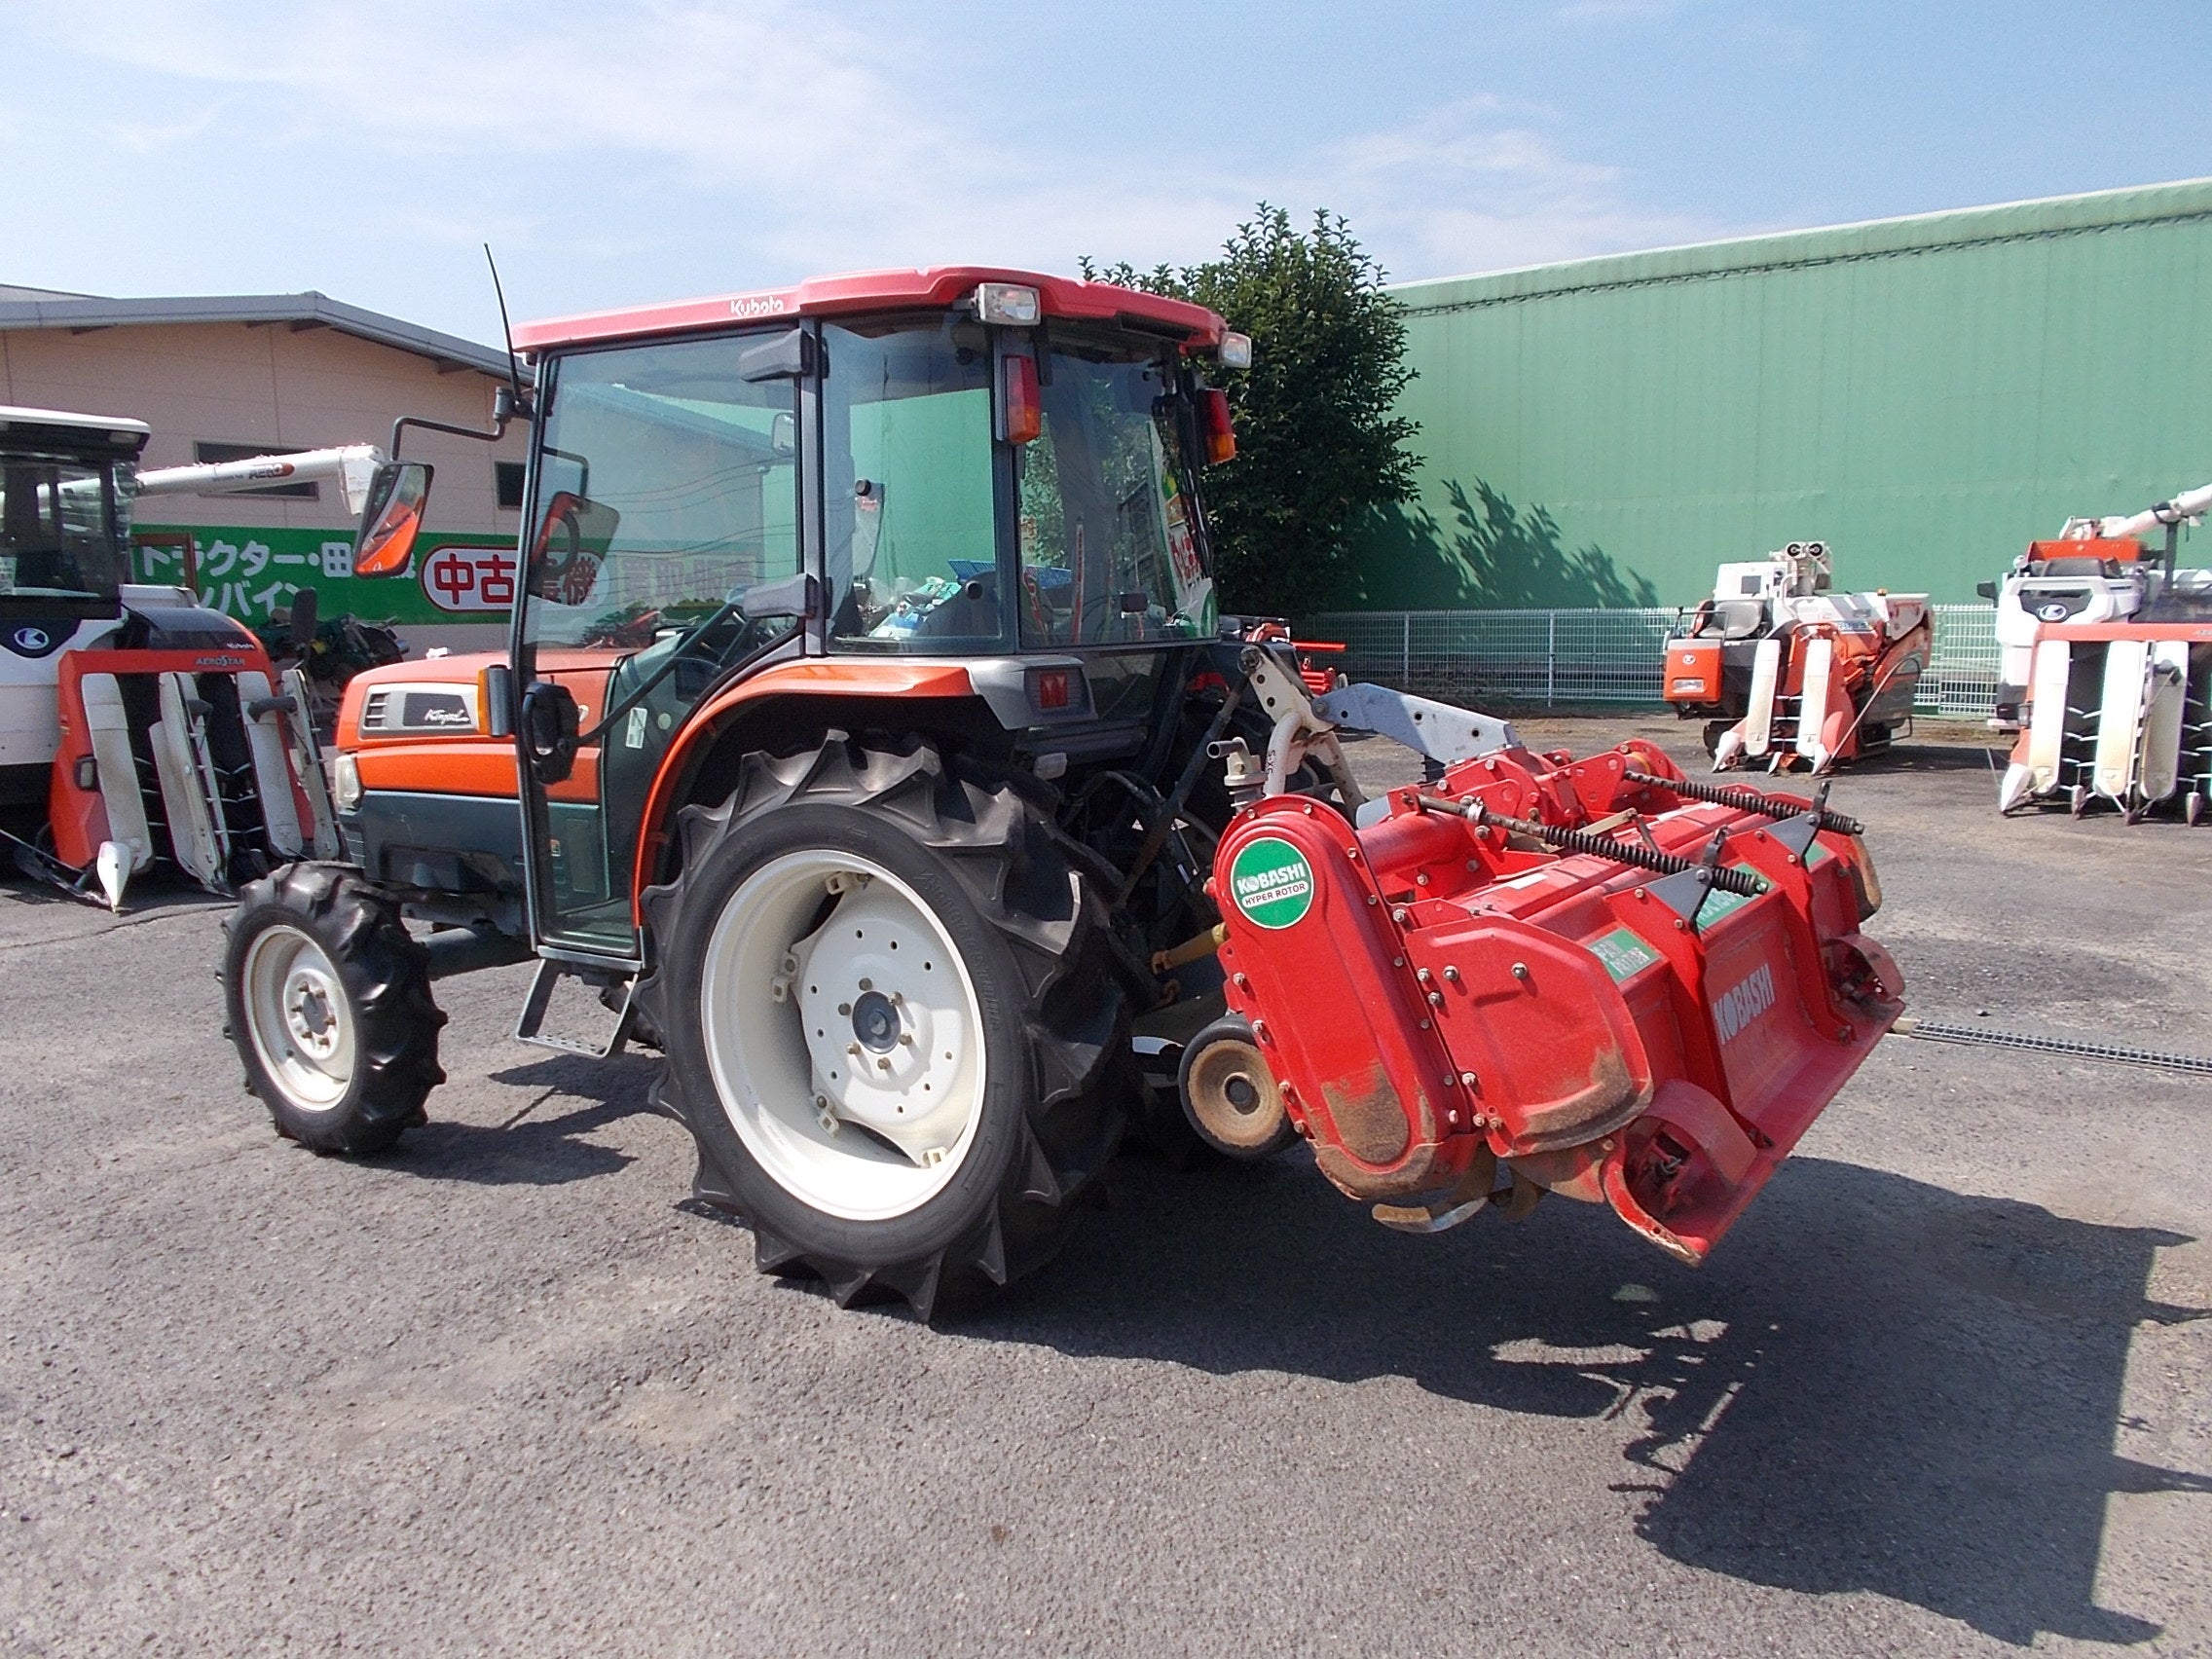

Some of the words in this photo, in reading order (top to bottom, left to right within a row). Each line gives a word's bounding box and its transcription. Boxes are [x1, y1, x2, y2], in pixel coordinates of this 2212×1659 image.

[730, 295, 784, 317] Kubota
[143, 539, 417, 579] トラクター・田
[196, 655, 245, 667] AEROSTAR
[1237, 863, 1306, 895] KOBASHI
[1245, 892, 1273, 905] HYPER
[1275, 883, 1306, 898] ROTOR
[1713, 962, 1776, 1047] KOBASHI
